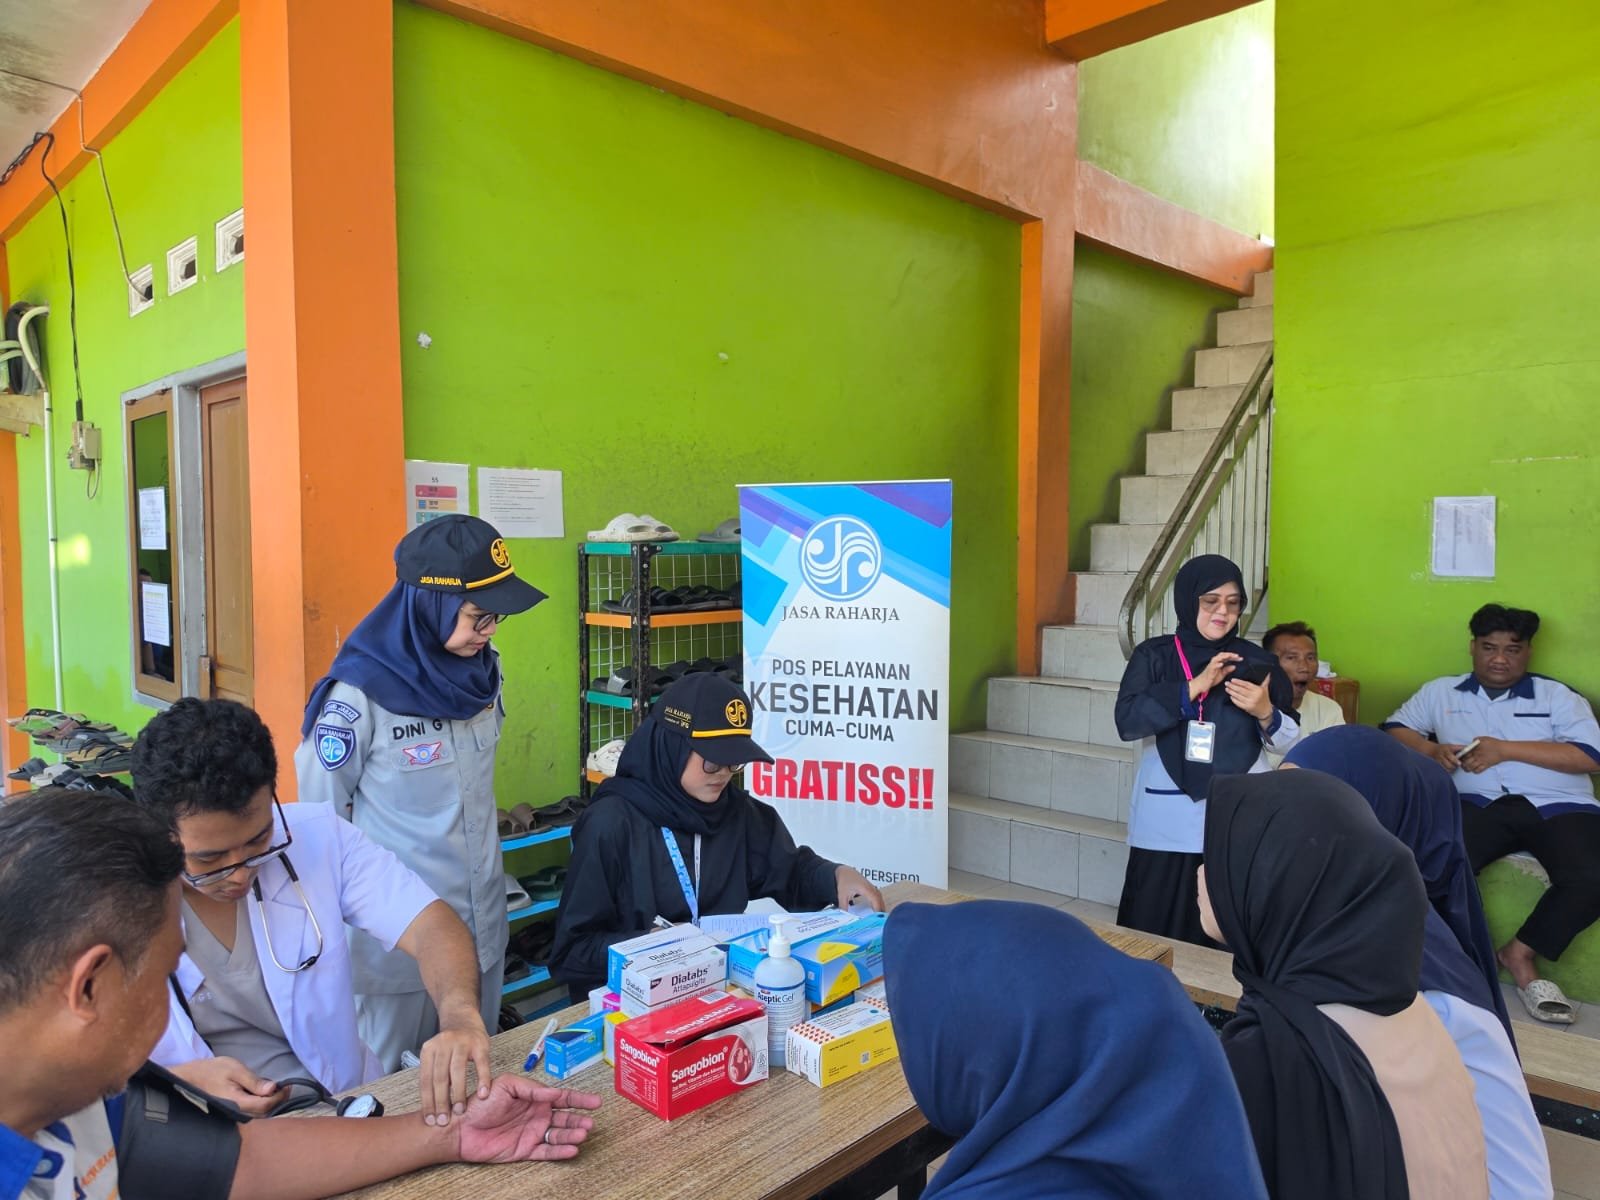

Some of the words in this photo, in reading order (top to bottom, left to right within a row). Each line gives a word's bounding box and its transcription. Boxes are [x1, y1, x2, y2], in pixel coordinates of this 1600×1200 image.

[782, 605, 820, 622] JASA
[825, 606, 900, 624] RAHARJA
[772, 659, 806, 676] POS
[812, 660, 911, 681] PELAYANAN
[749, 681, 939, 721] KESEHATAN
[392, 723, 426, 740] DINI
[433, 718, 443, 731] G
[786, 719, 895, 742] CUMA-CUMA
[752, 758, 935, 810] GRATISS!!
[671, 967, 709, 987] Diatabs
[782, 993, 794, 1002] Gel
[620, 1038, 657, 1068] Sangobion
[671, 1051, 725, 1083] Sangobion
